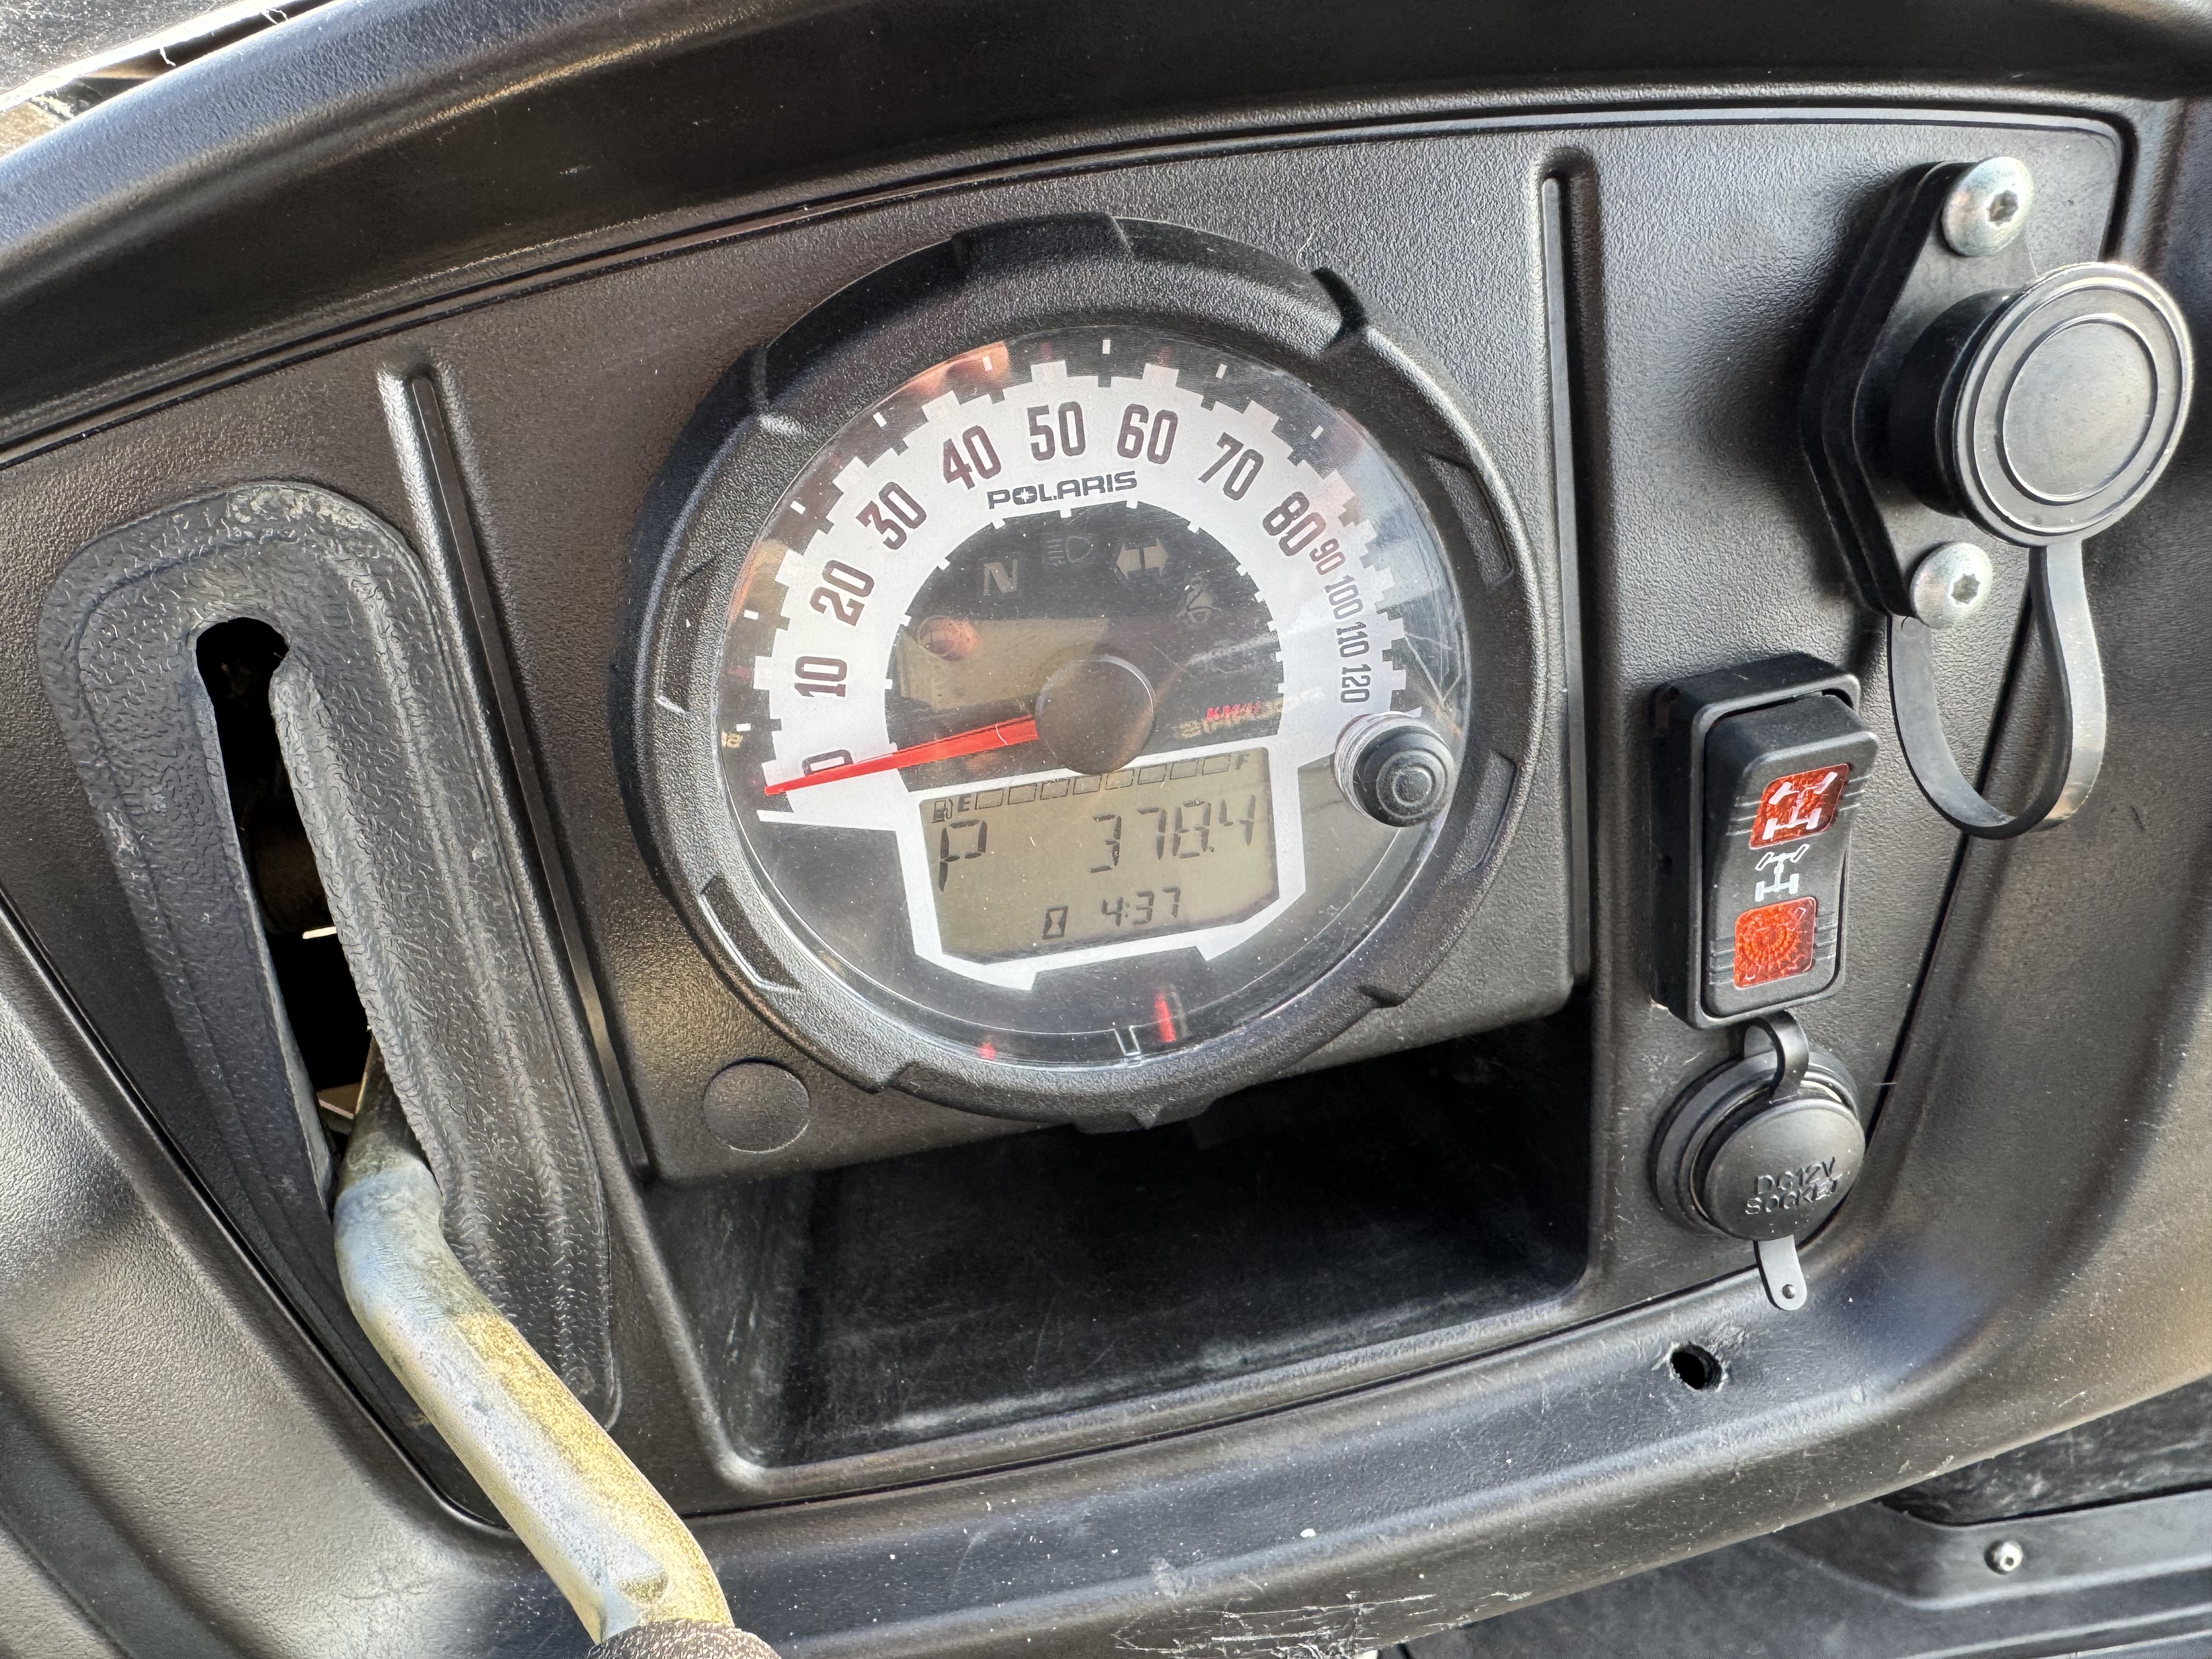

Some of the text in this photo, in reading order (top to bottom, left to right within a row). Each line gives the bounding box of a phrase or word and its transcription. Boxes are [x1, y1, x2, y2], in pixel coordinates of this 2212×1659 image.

[943, 425, 1001, 490] 40
[1027, 401, 1086, 461] 50
[1117, 403, 1178, 465] 60
[987, 470, 1137, 510] POLARIS
[1197, 432, 1264, 501] 70
[855, 481, 927, 550] 30
[1262, 491, 1327, 557] 80
[983, 551, 1018, 596] N
[1309, 538, 1346, 575] 90
[809, 560, 875, 627] 20
[1324, 574, 1363, 620] 100
[1336, 621, 1370, 658] 110
[794, 656, 847, 698] 10
[1340, 663, 1371, 704] 120
[957, 753, 1251, 812] E F
[939, 794, 1257, 892] P 378.4
[1101, 887, 1182, 927] 4:37
